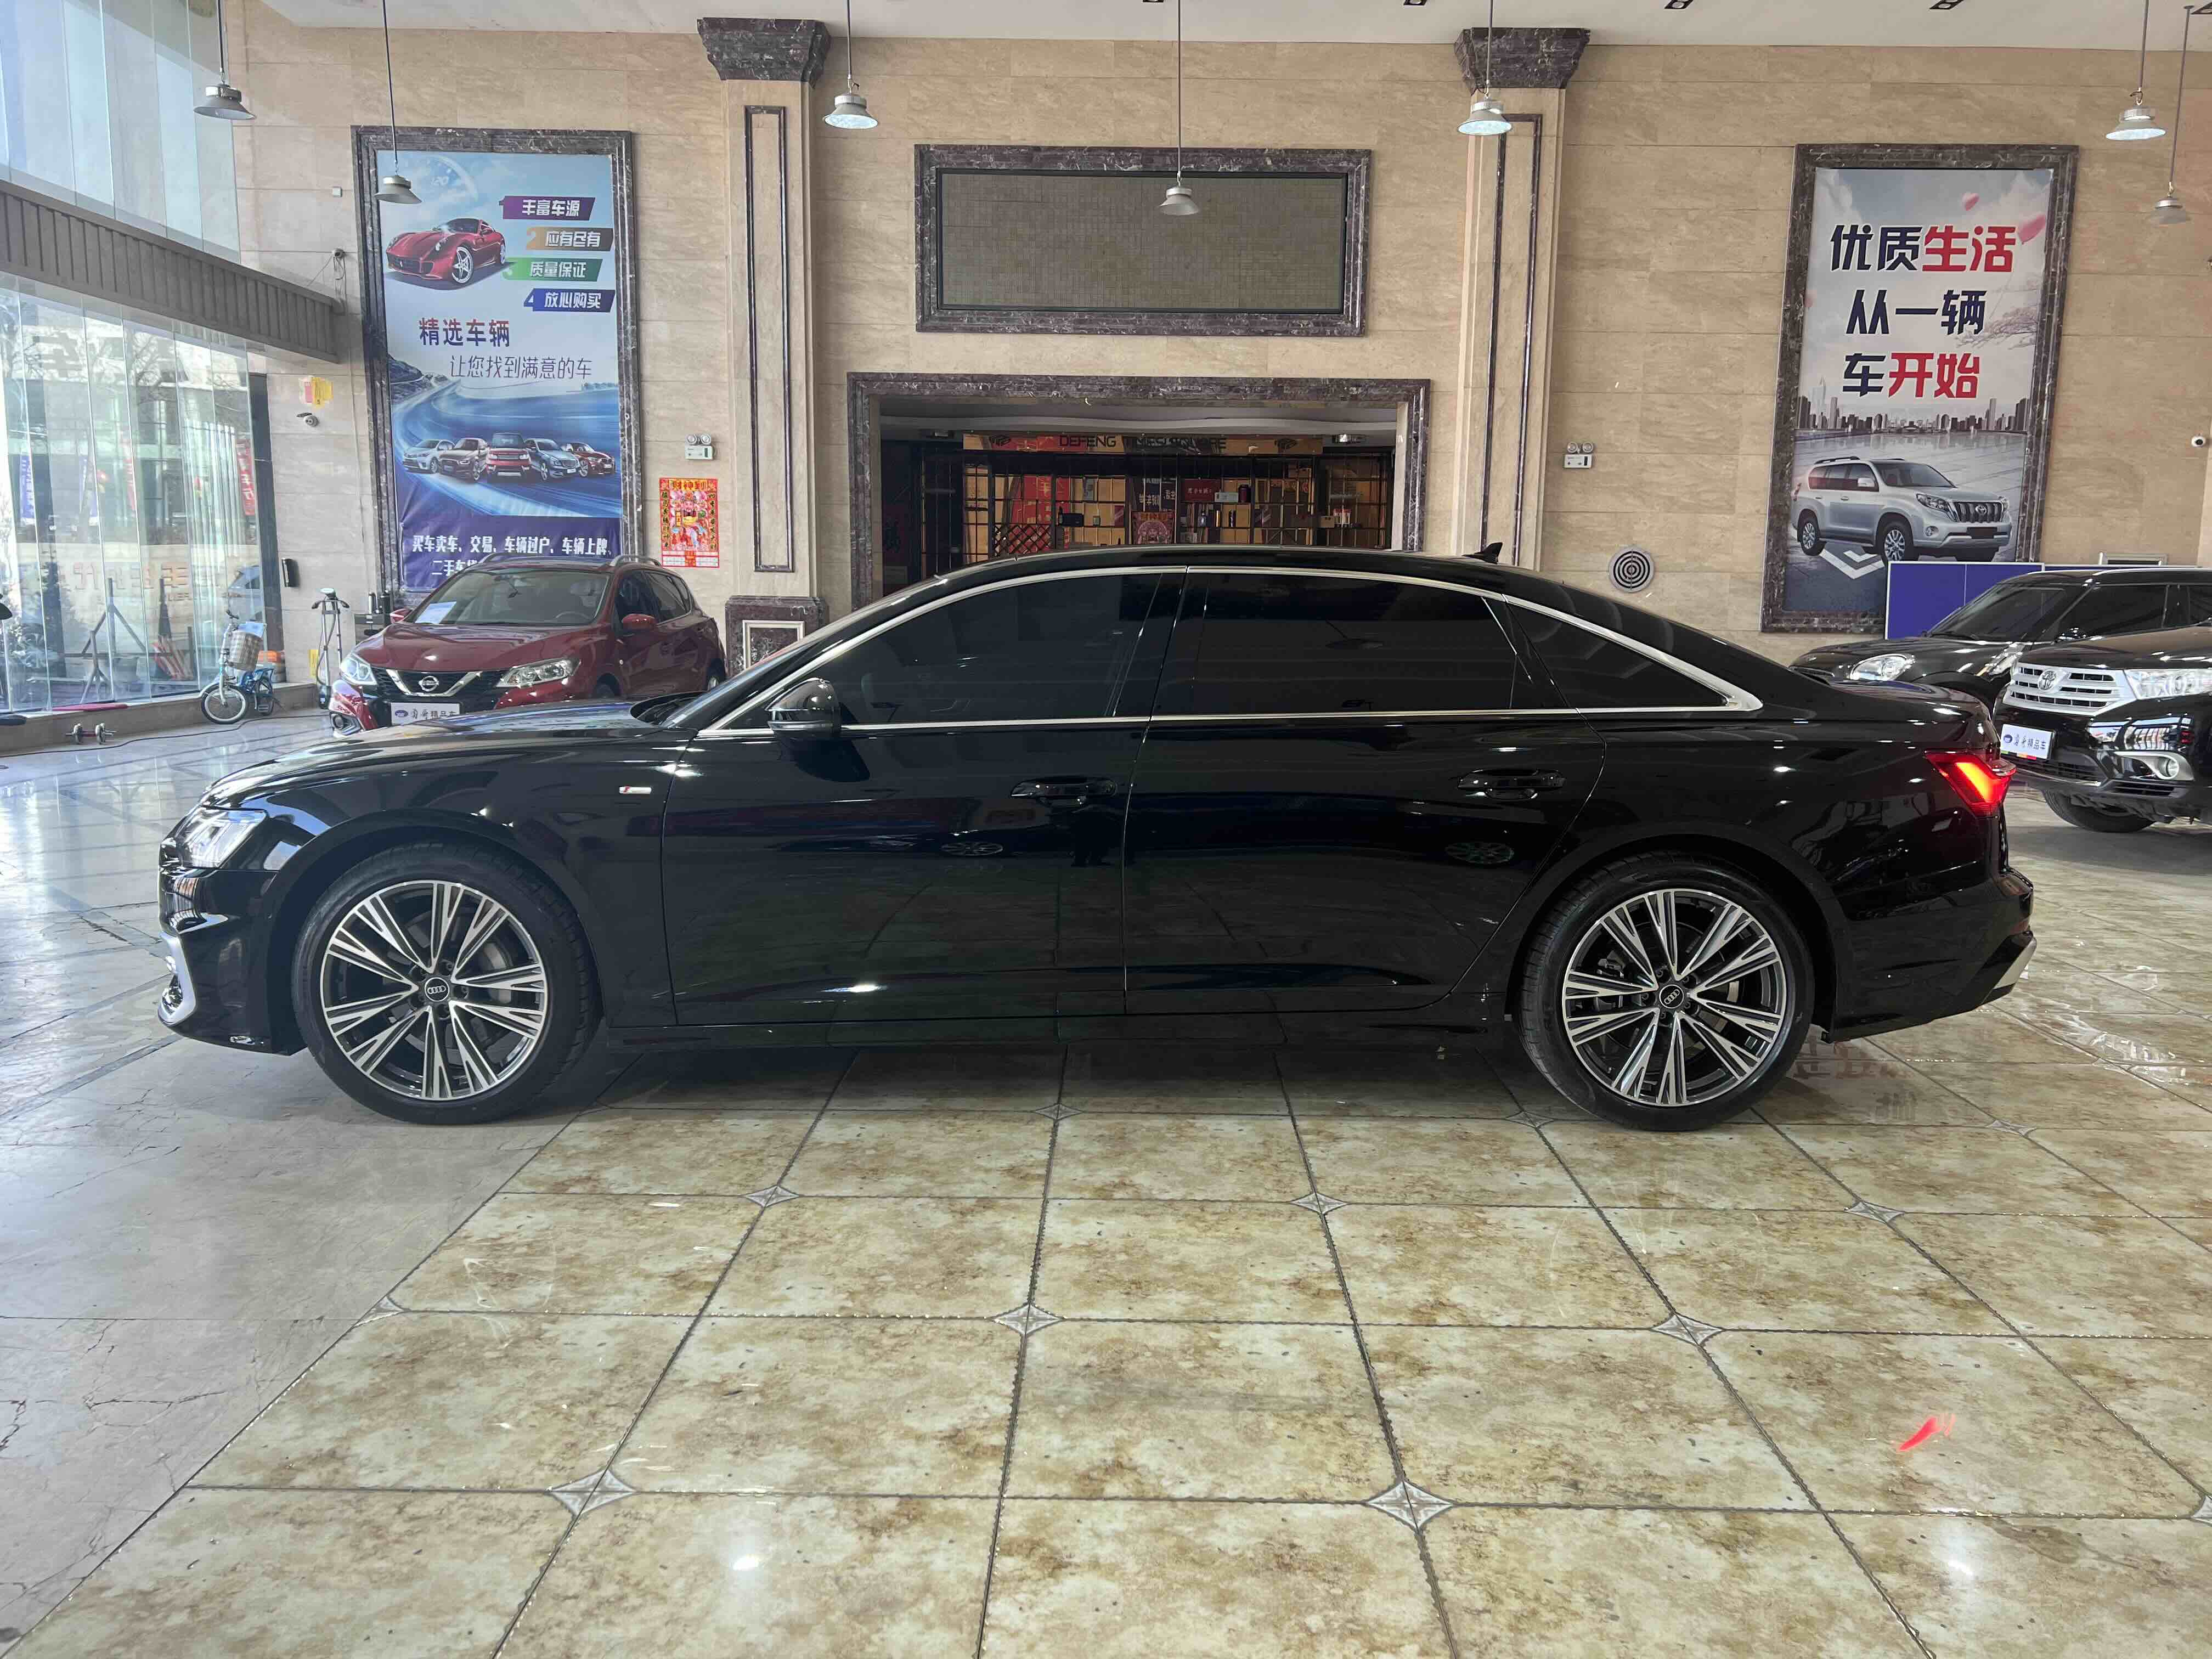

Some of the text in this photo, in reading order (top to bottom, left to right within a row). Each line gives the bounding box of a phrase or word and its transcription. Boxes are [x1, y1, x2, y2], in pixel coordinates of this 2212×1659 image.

[522, 199, 580, 217] 丰富车源
[545, 231, 601, 247] 应有尽有
[1830, 224, 2017, 272] 优质生活
[530, 261, 587, 278] 质量保证
[544, 292, 602, 308] 放心购买
[1846, 289, 1988, 335] 从一辆
[419, 317, 510, 347] 精选车辆
[450, 355, 593, 380] 让您找到满意的车
[1842, 352, 1980, 398] 车开始
